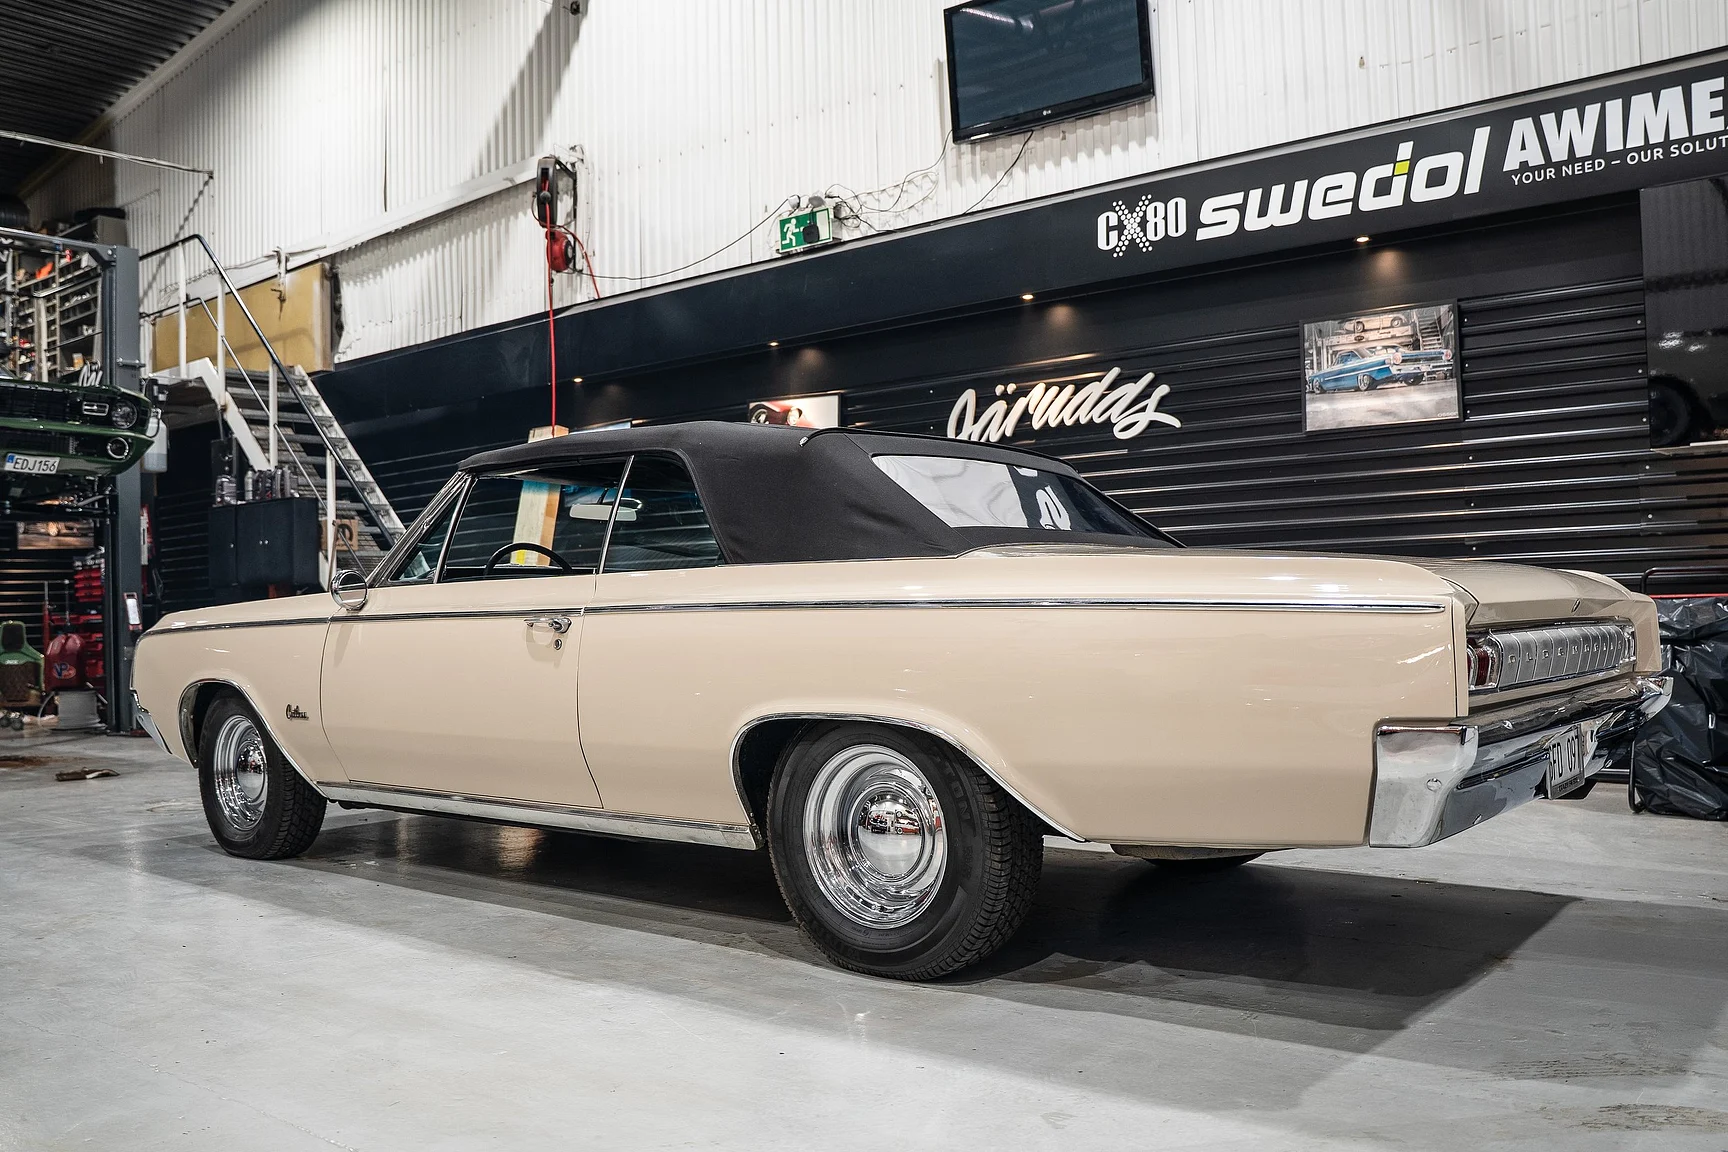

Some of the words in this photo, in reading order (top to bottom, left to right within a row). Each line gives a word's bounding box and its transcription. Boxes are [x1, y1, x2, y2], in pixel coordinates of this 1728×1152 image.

[1503, 76, 1728, 172] AWIME
[1196, 127, 1490, 241] swedol
[1511, 168, 1556, 186] YOUR
[1562, 158, 1606, 177] NEED
[1626, 148, 1664, 165] OUR
[1097, 194, 1187, 258] CX80
